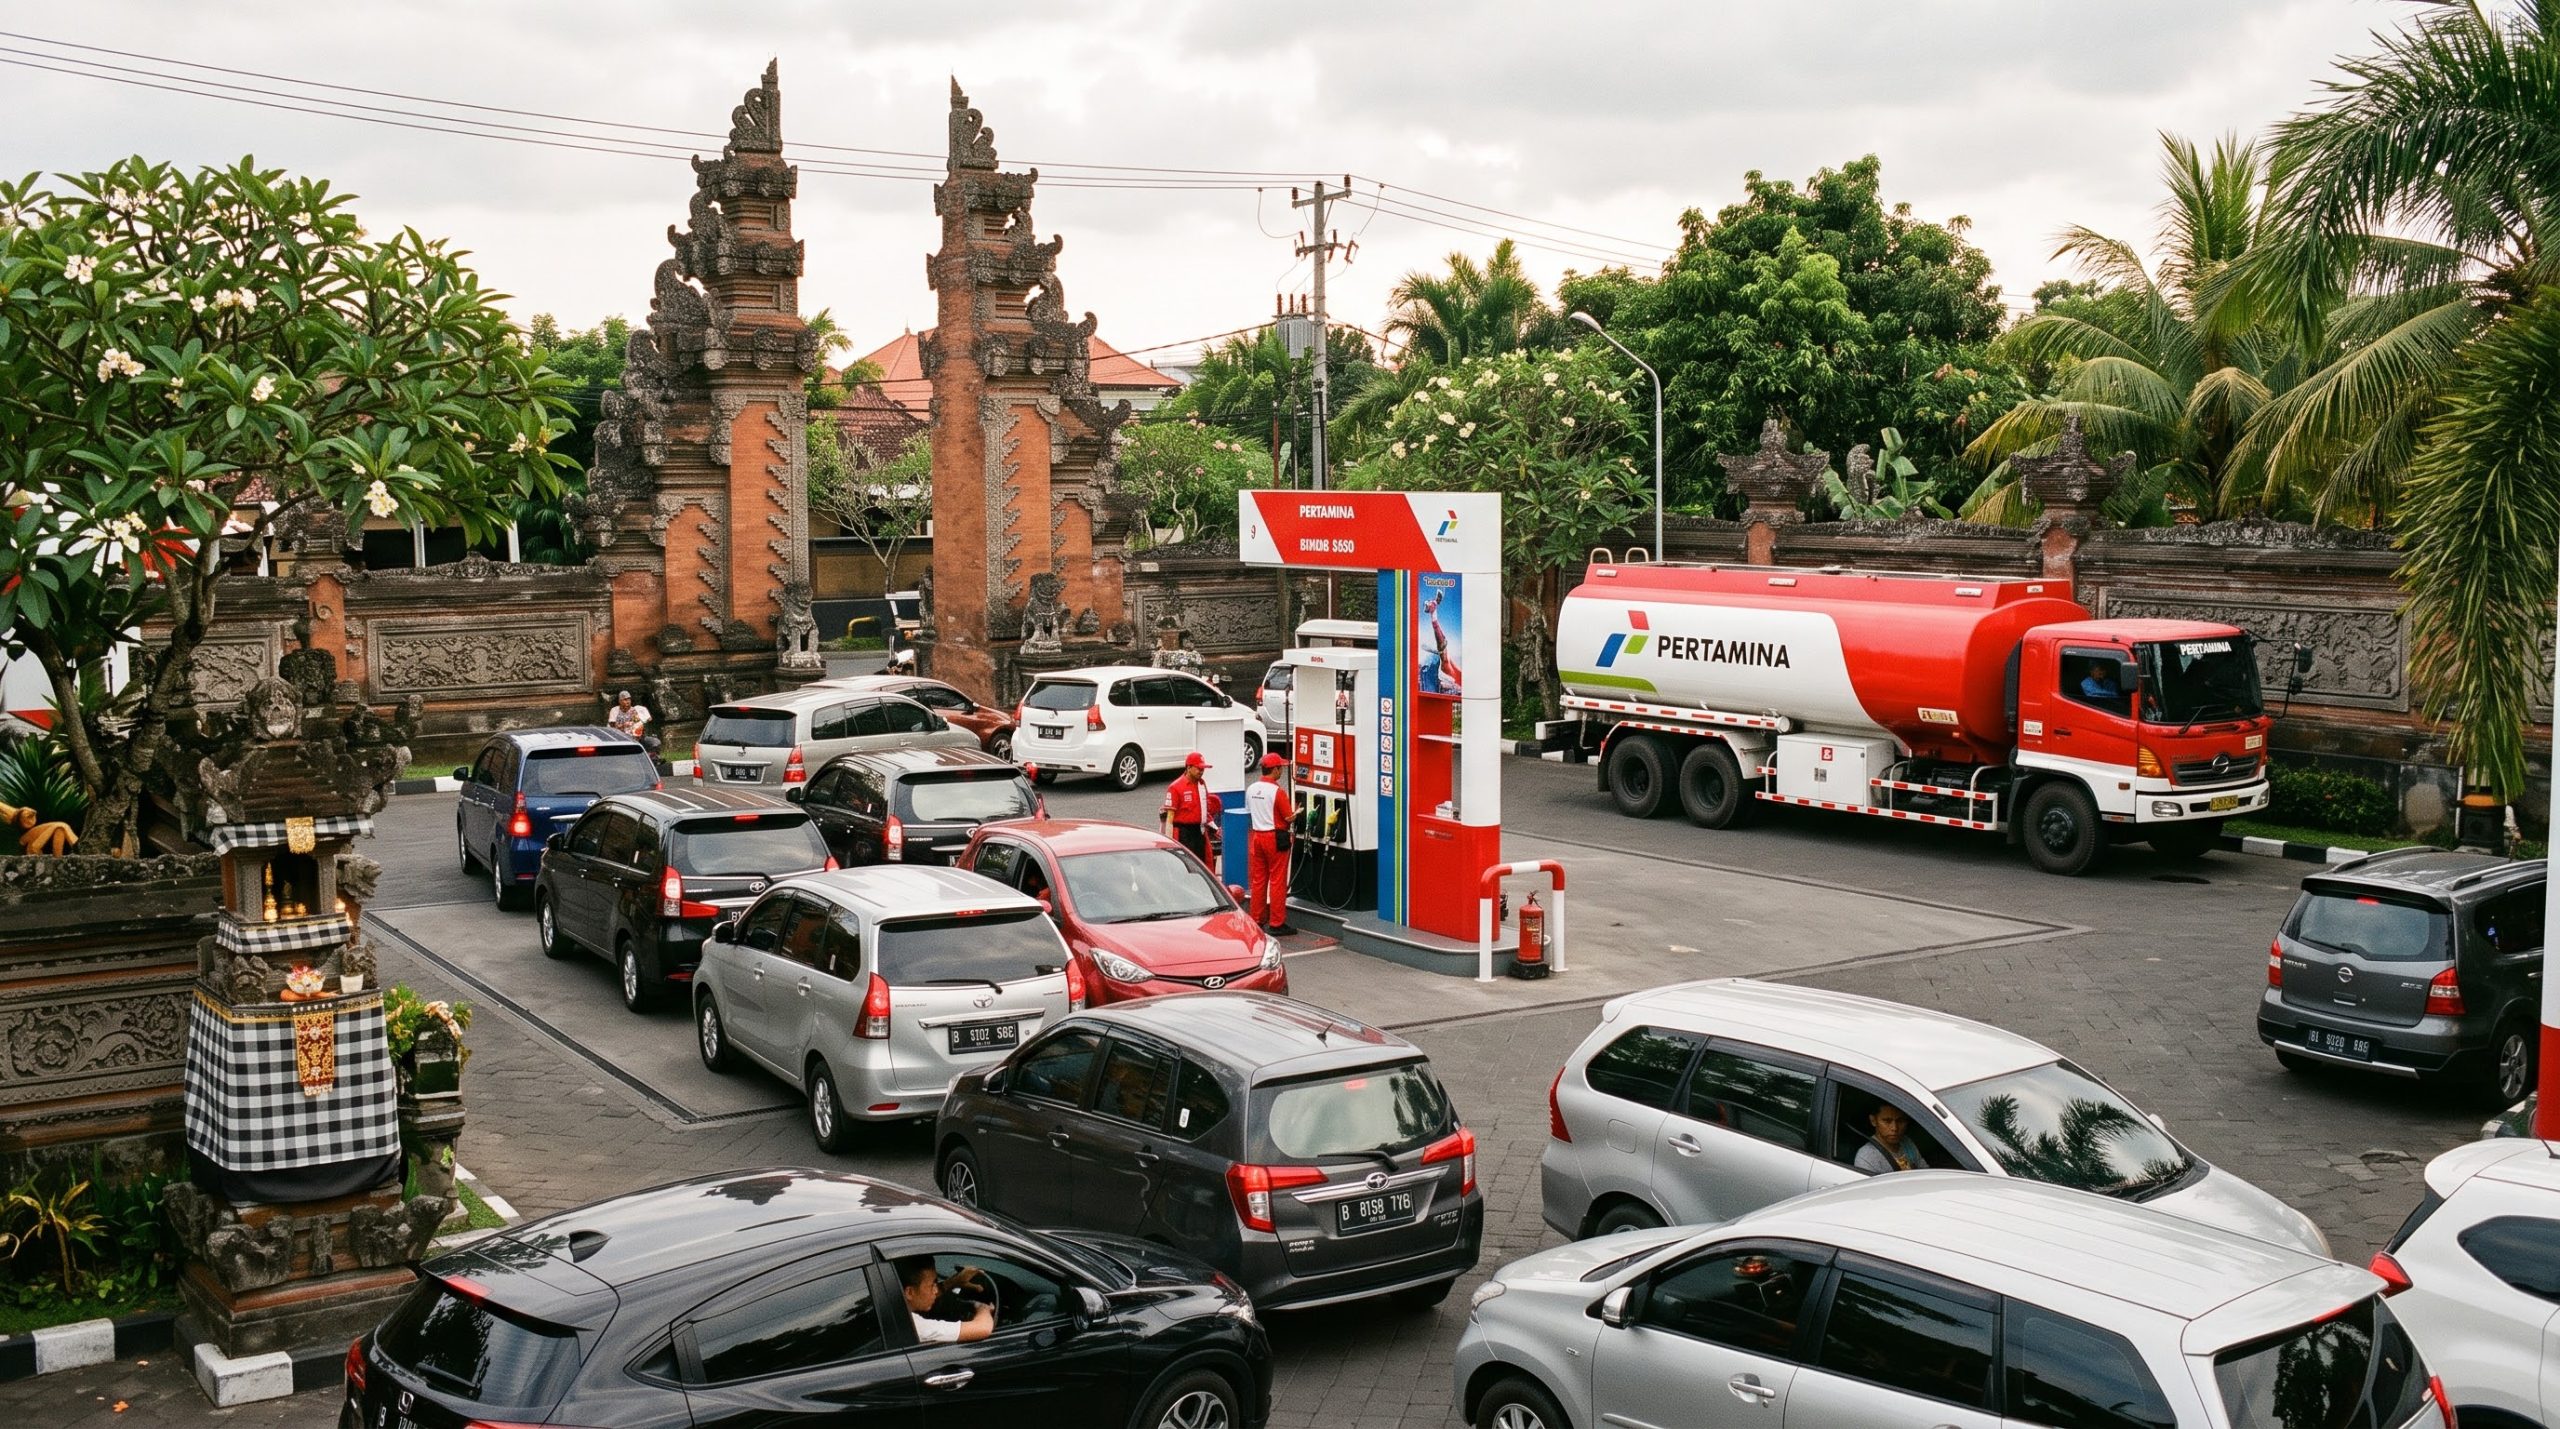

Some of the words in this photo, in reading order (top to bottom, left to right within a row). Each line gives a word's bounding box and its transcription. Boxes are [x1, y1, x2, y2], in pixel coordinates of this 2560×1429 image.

[1299, 505, 1355, 519] PERTAMINA
[1657, 635, 1791, 669] PERTAMINA
[1341, 1204, 1350, 1221] B
